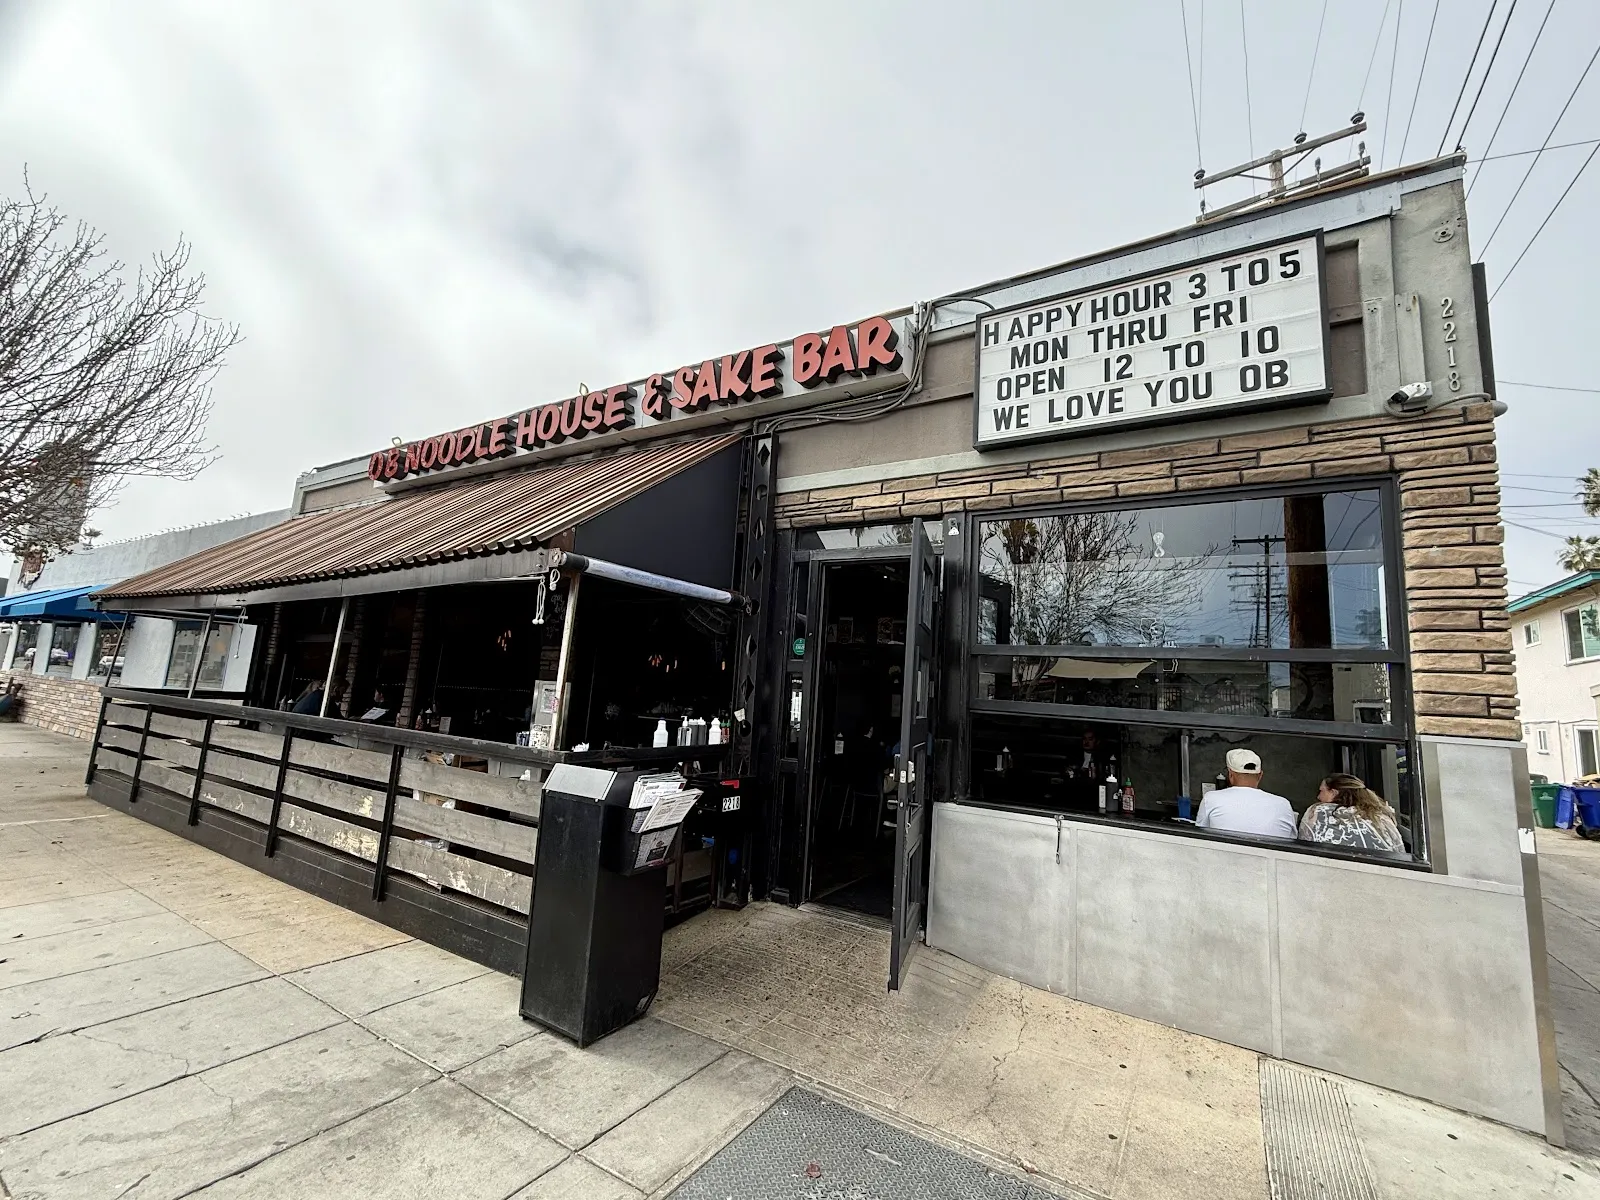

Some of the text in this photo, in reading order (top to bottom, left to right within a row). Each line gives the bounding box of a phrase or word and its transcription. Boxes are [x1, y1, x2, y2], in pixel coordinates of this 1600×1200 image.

[1090, 280, 1172, 323] HOUR
[1188, 272, 1207, 300] 3
[1221, 257, 1269, 292] TO
[1279, 250, 1300, 279] 5
[1010, 296, 1247, 370] MON THRU FRI
[368, 315, 898, 481] OB NOODLE HOUSE & SAKE BAR
[993, 359, 1289, 432] WE LOVE YOU OB
[997, 366, 1065, 401] OPEN
[1104, 353, 1133, 383] 12
[1162, 340, 1205, 371] TO
[723, 796, 740, 811] 2218
